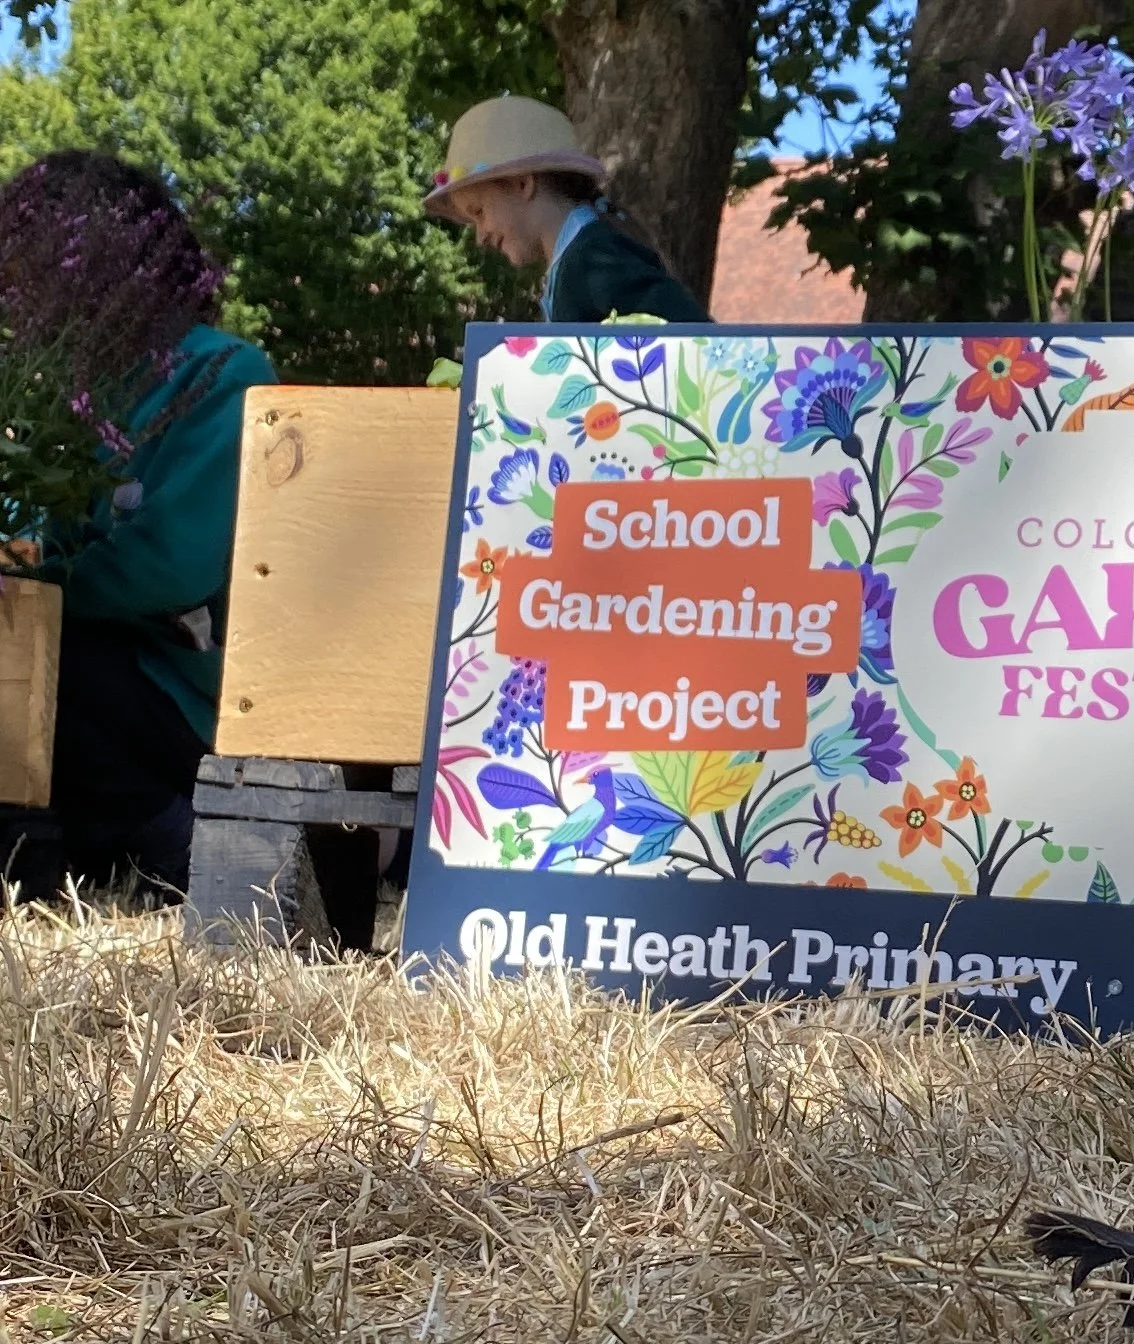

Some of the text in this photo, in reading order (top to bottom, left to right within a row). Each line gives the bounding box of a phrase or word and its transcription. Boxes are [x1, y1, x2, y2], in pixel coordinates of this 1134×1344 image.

[582, 496, 780, 550] School
[518, 579, 838, 656] Gardening
[566, 677, 781, 741] Project
[459, 908, 1077, 1015] Old Heath Primary
